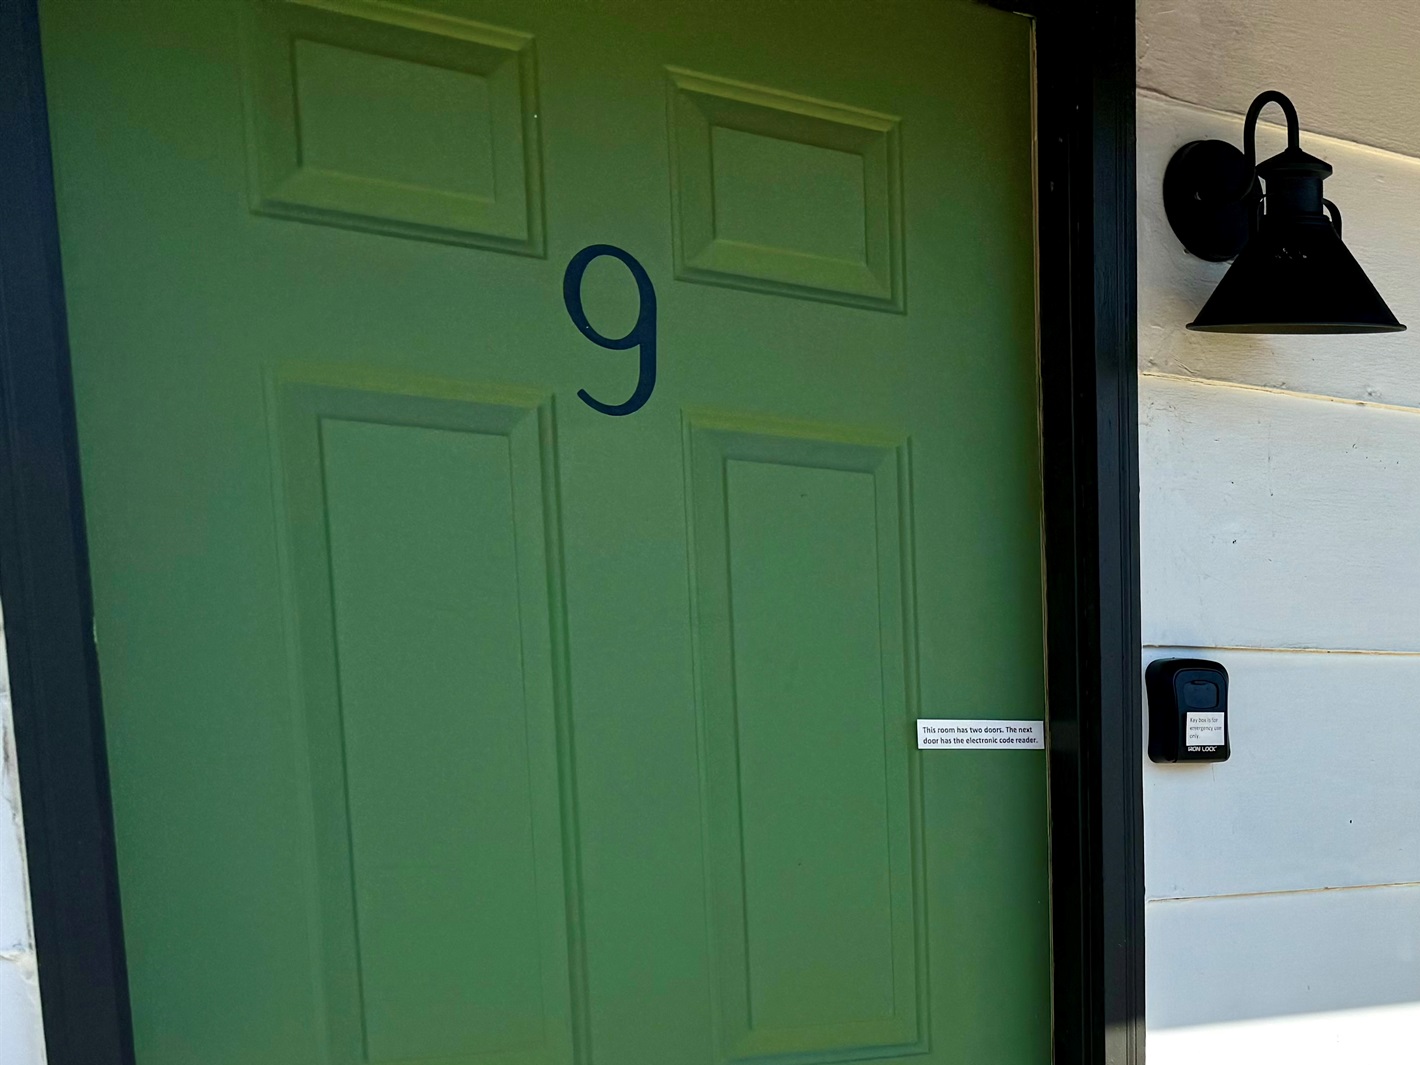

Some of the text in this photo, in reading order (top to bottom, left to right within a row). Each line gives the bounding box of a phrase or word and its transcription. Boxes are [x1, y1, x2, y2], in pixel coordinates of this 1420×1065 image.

[562, 243, 657, 417] 9
[922, 726, 936, 734] This
[956, 726, 969, 734] has
[969, 726, 983, 734] two
[983, 726, 1004, 734] doors.
[1005, 726, 1017, 734] The
[1018, 726, 1033, 734] next
[923, 737, 939, 745] door
